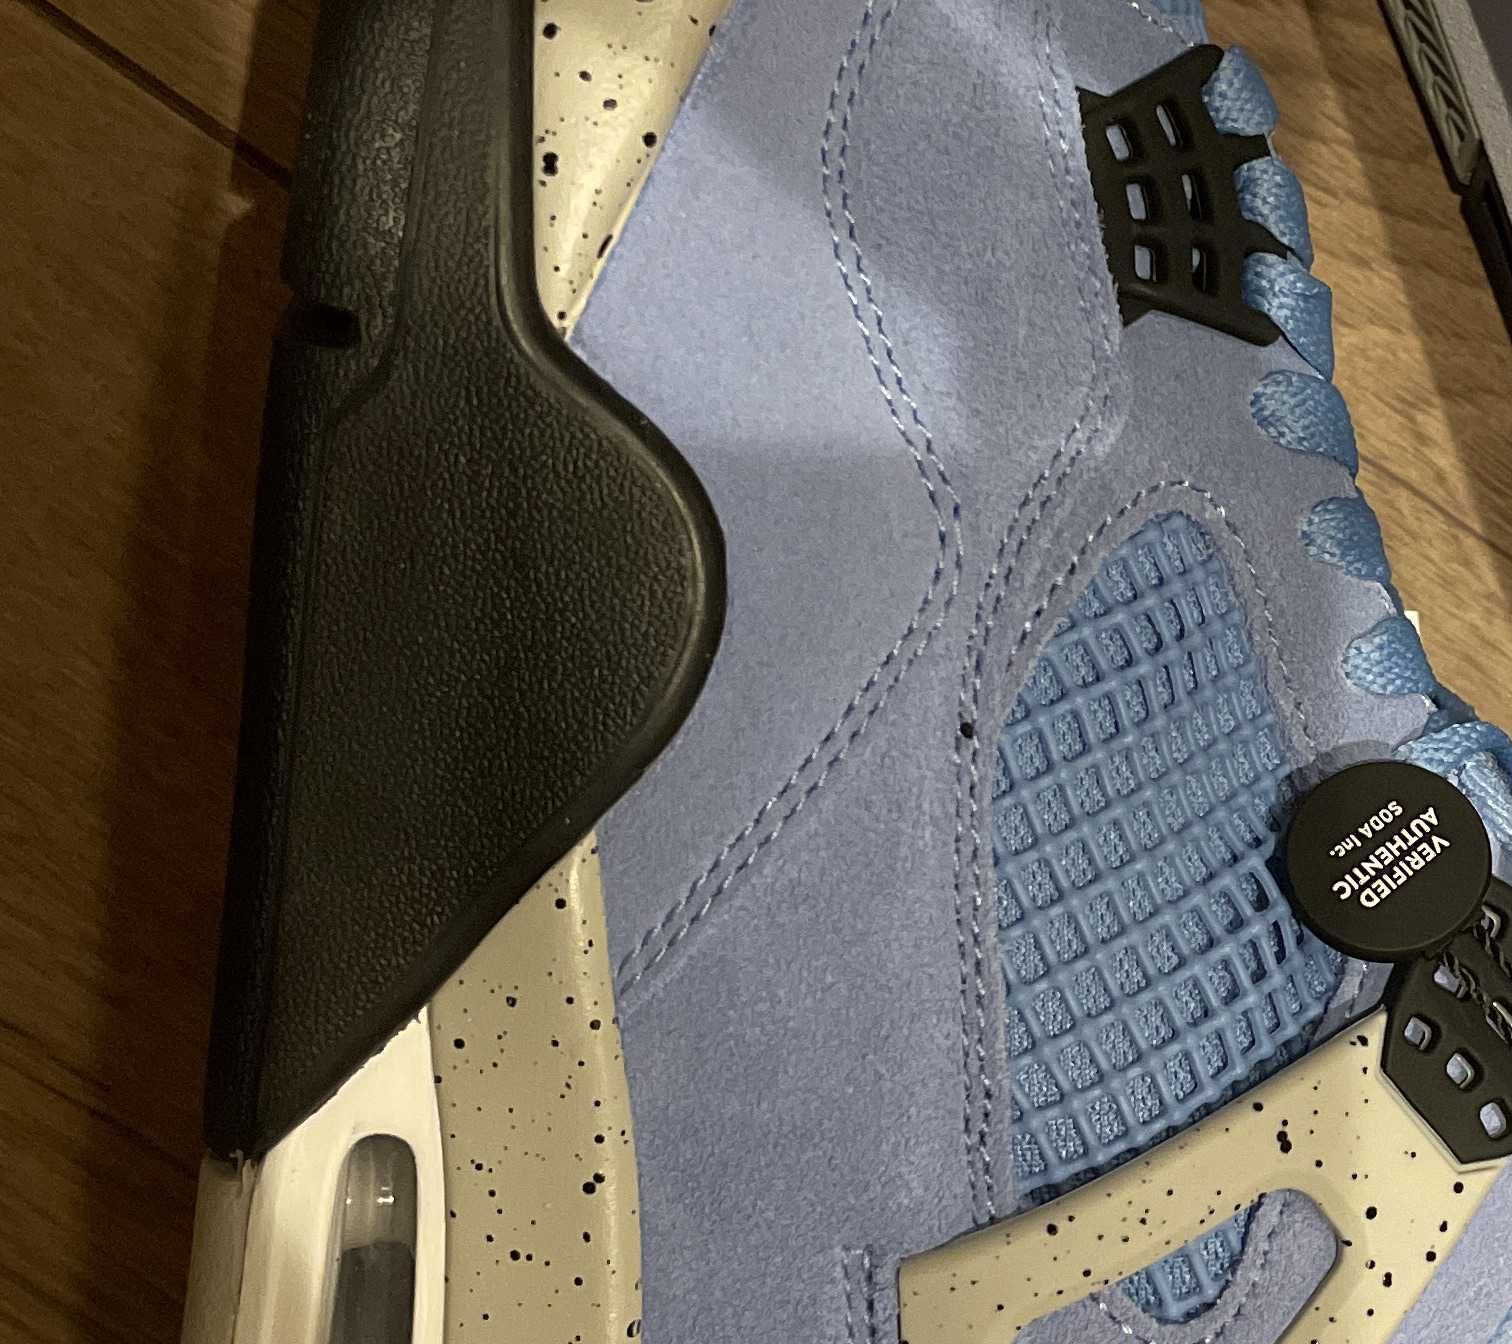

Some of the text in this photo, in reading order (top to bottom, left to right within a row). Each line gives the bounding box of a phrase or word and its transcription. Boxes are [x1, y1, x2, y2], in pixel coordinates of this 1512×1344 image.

[1329, 800, 1403, 857] SODA Inc.
[1332, 807, 1439, 900] AUTHENTIC
[1359, 835, 1451, 908] VERIFIED
